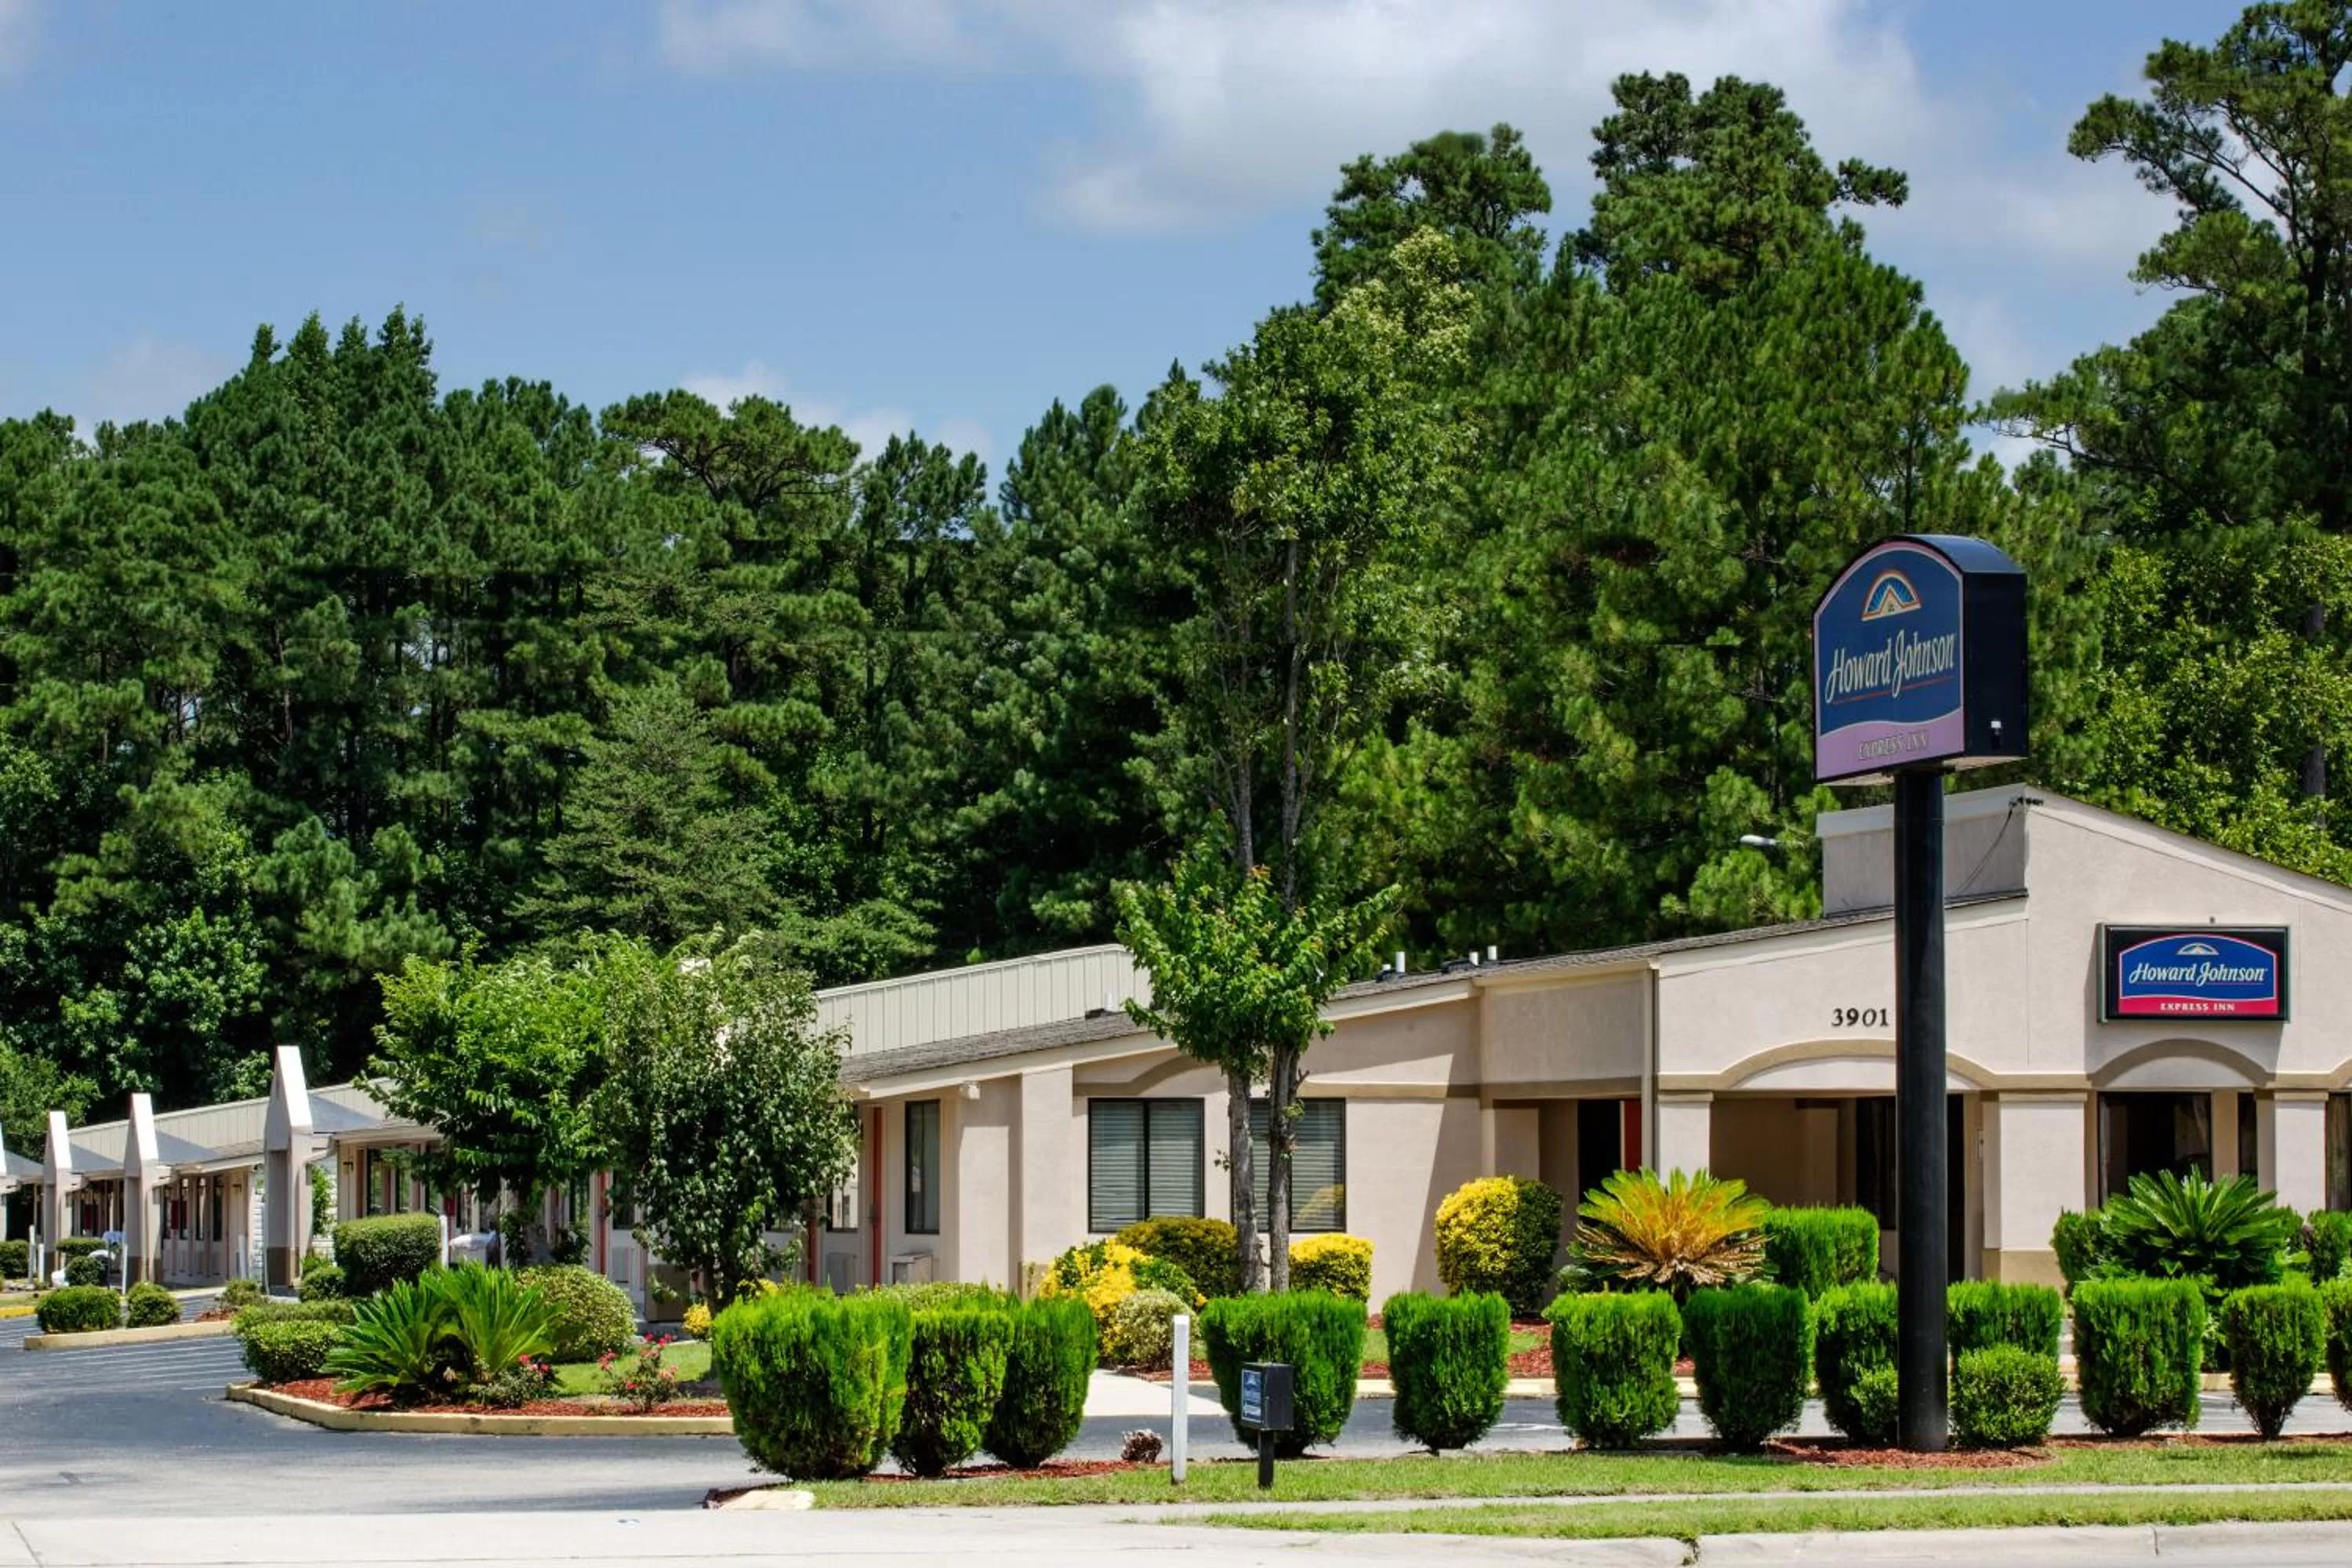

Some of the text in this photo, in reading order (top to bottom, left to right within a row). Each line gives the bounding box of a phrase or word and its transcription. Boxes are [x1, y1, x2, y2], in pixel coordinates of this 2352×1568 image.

[1825, 629, 1955, 703] Howard Johnson
[2129, 961, 2266, 987] Howard Johnson
[1831, 1007, 1889, 1027] 3901
[2160, 1003, 2234, 1011] EXPRESS INN
